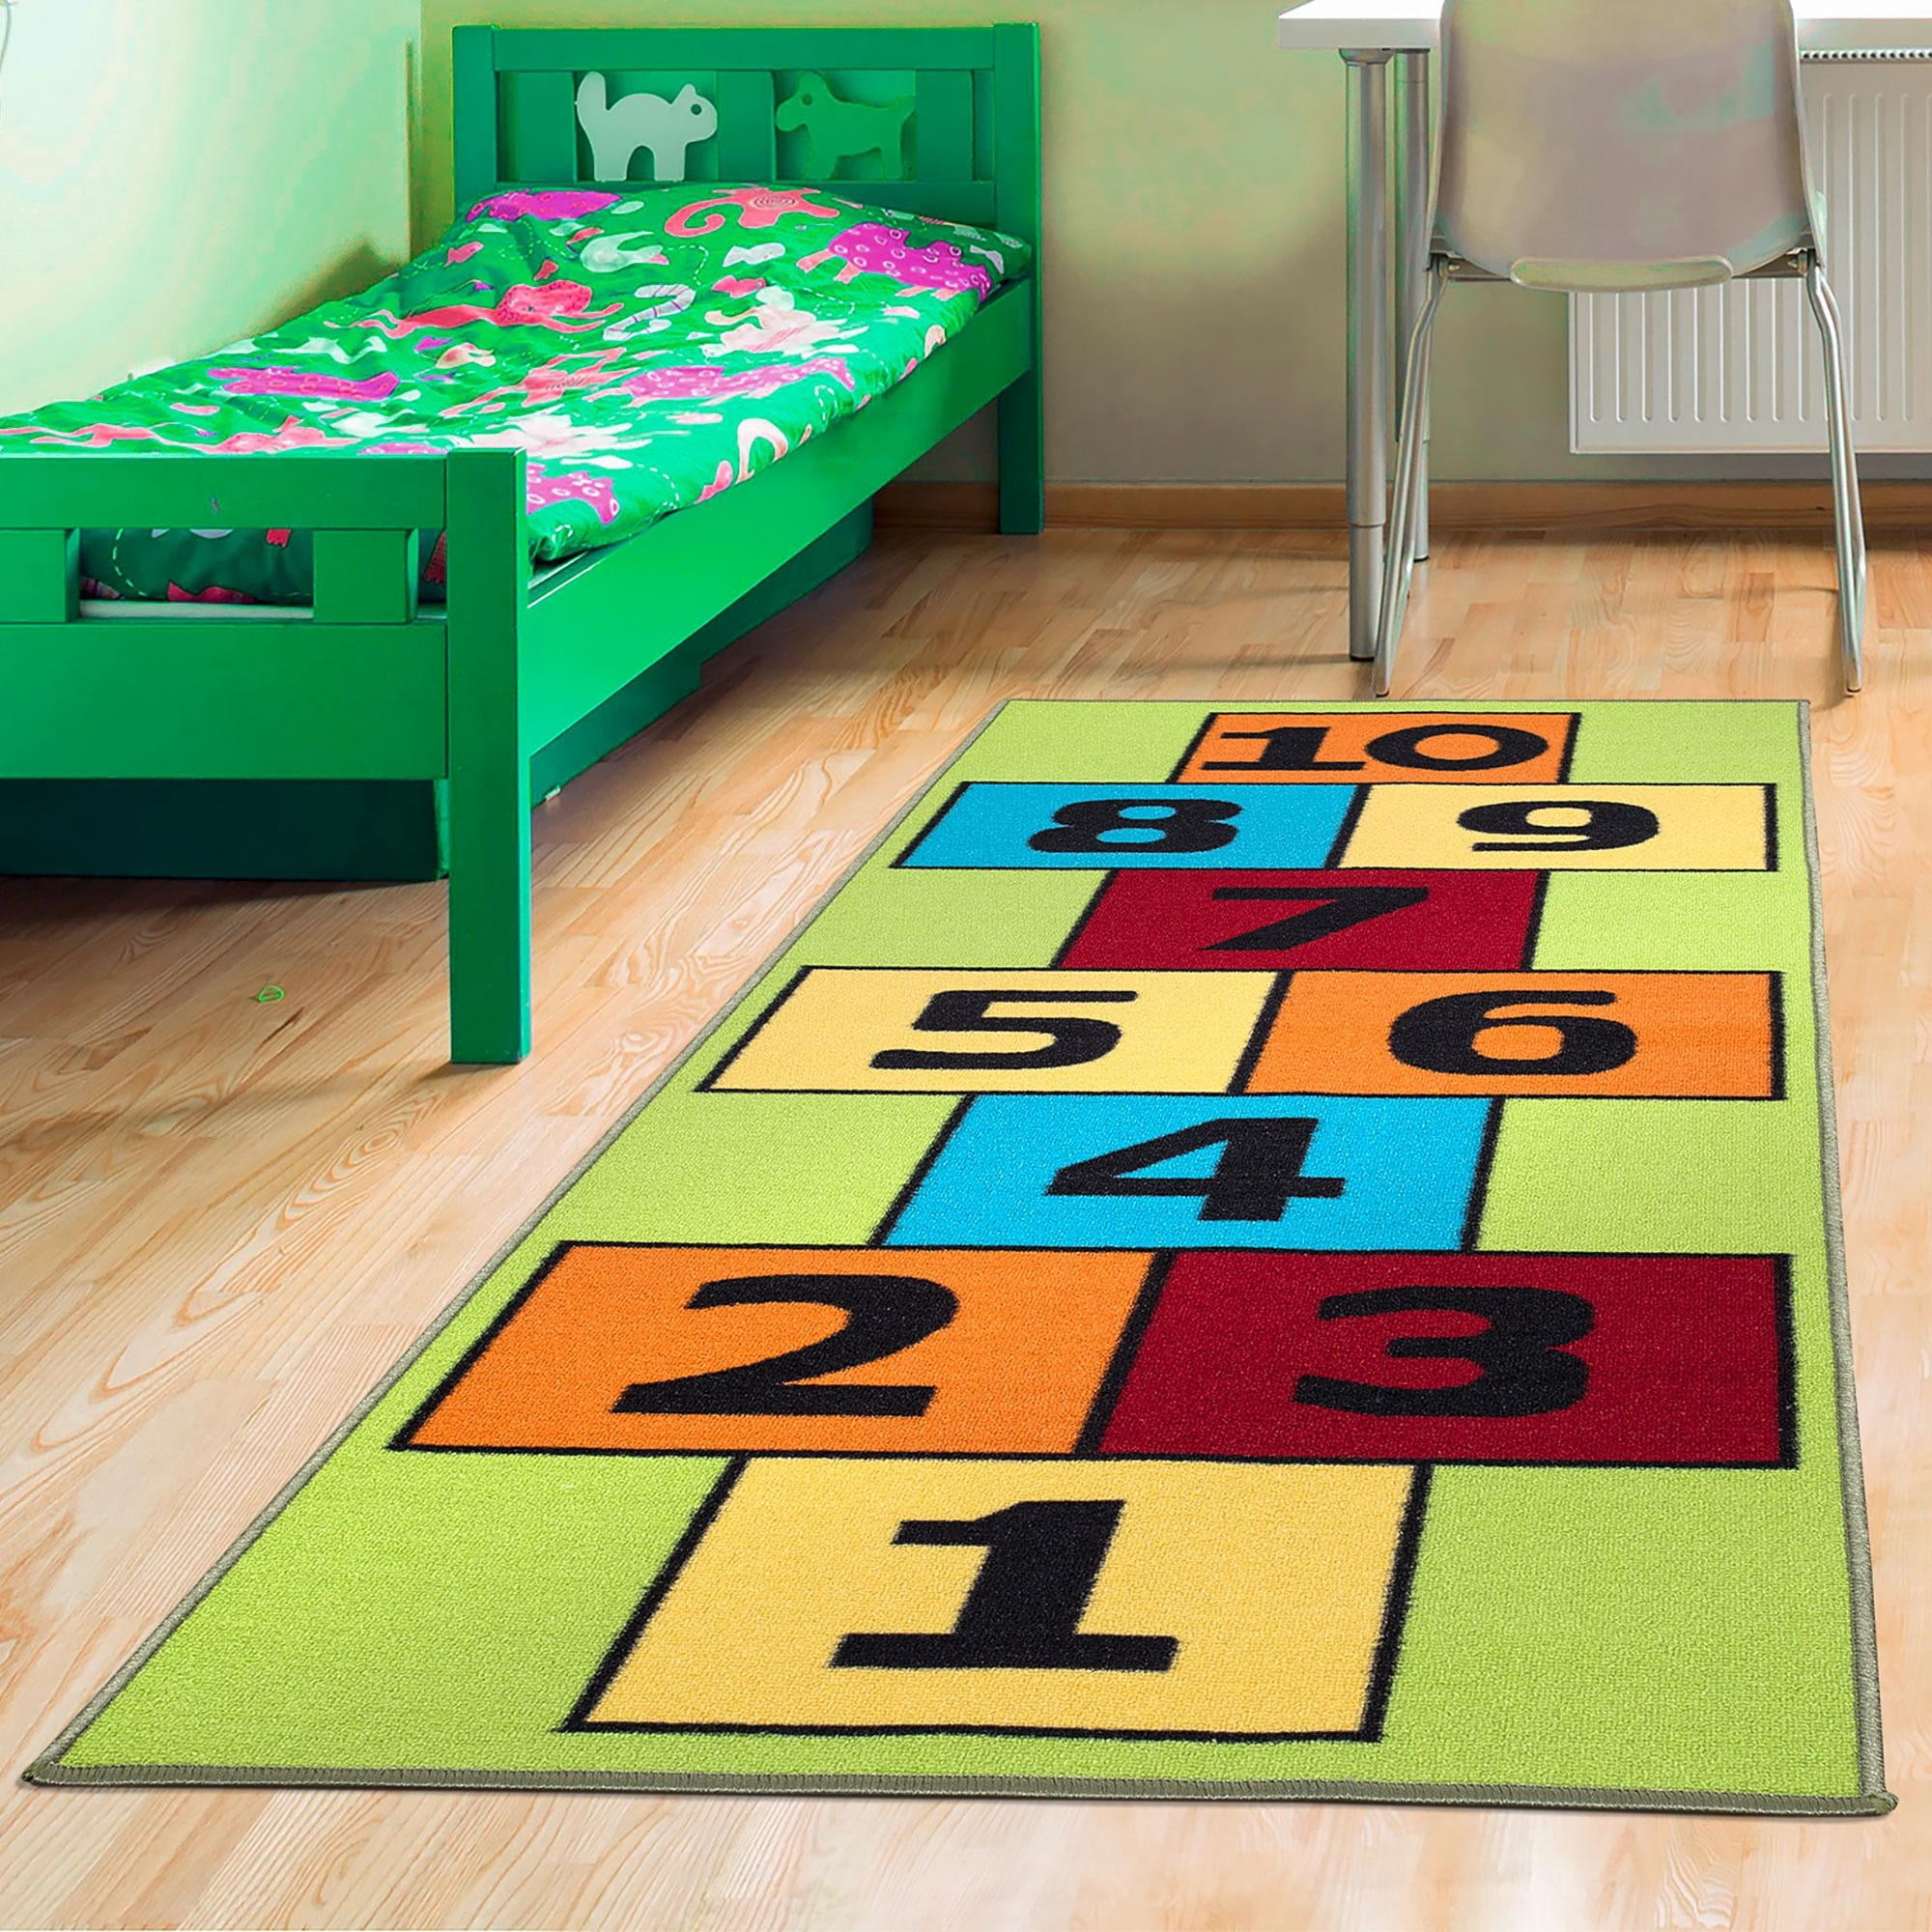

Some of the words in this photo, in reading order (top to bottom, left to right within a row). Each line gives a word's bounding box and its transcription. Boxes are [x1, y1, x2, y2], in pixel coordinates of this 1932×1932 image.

[1201, 724, 1548, 772] 10
[1028, 799, 1243, 853] 8
[1457, 800, 1660, 852] 9
[1200, 886, 1430, 952] 7
[869, 990, 1138, 1070] 5
[1388, 990, 1637, 1076] 6
[1045, 1117, 1346, 1222] 4
[611, 1274, 958, 1417] 2
[1291, 1285, 1596, 1419] 3
[831, 1499, 1179, 1672] 1
